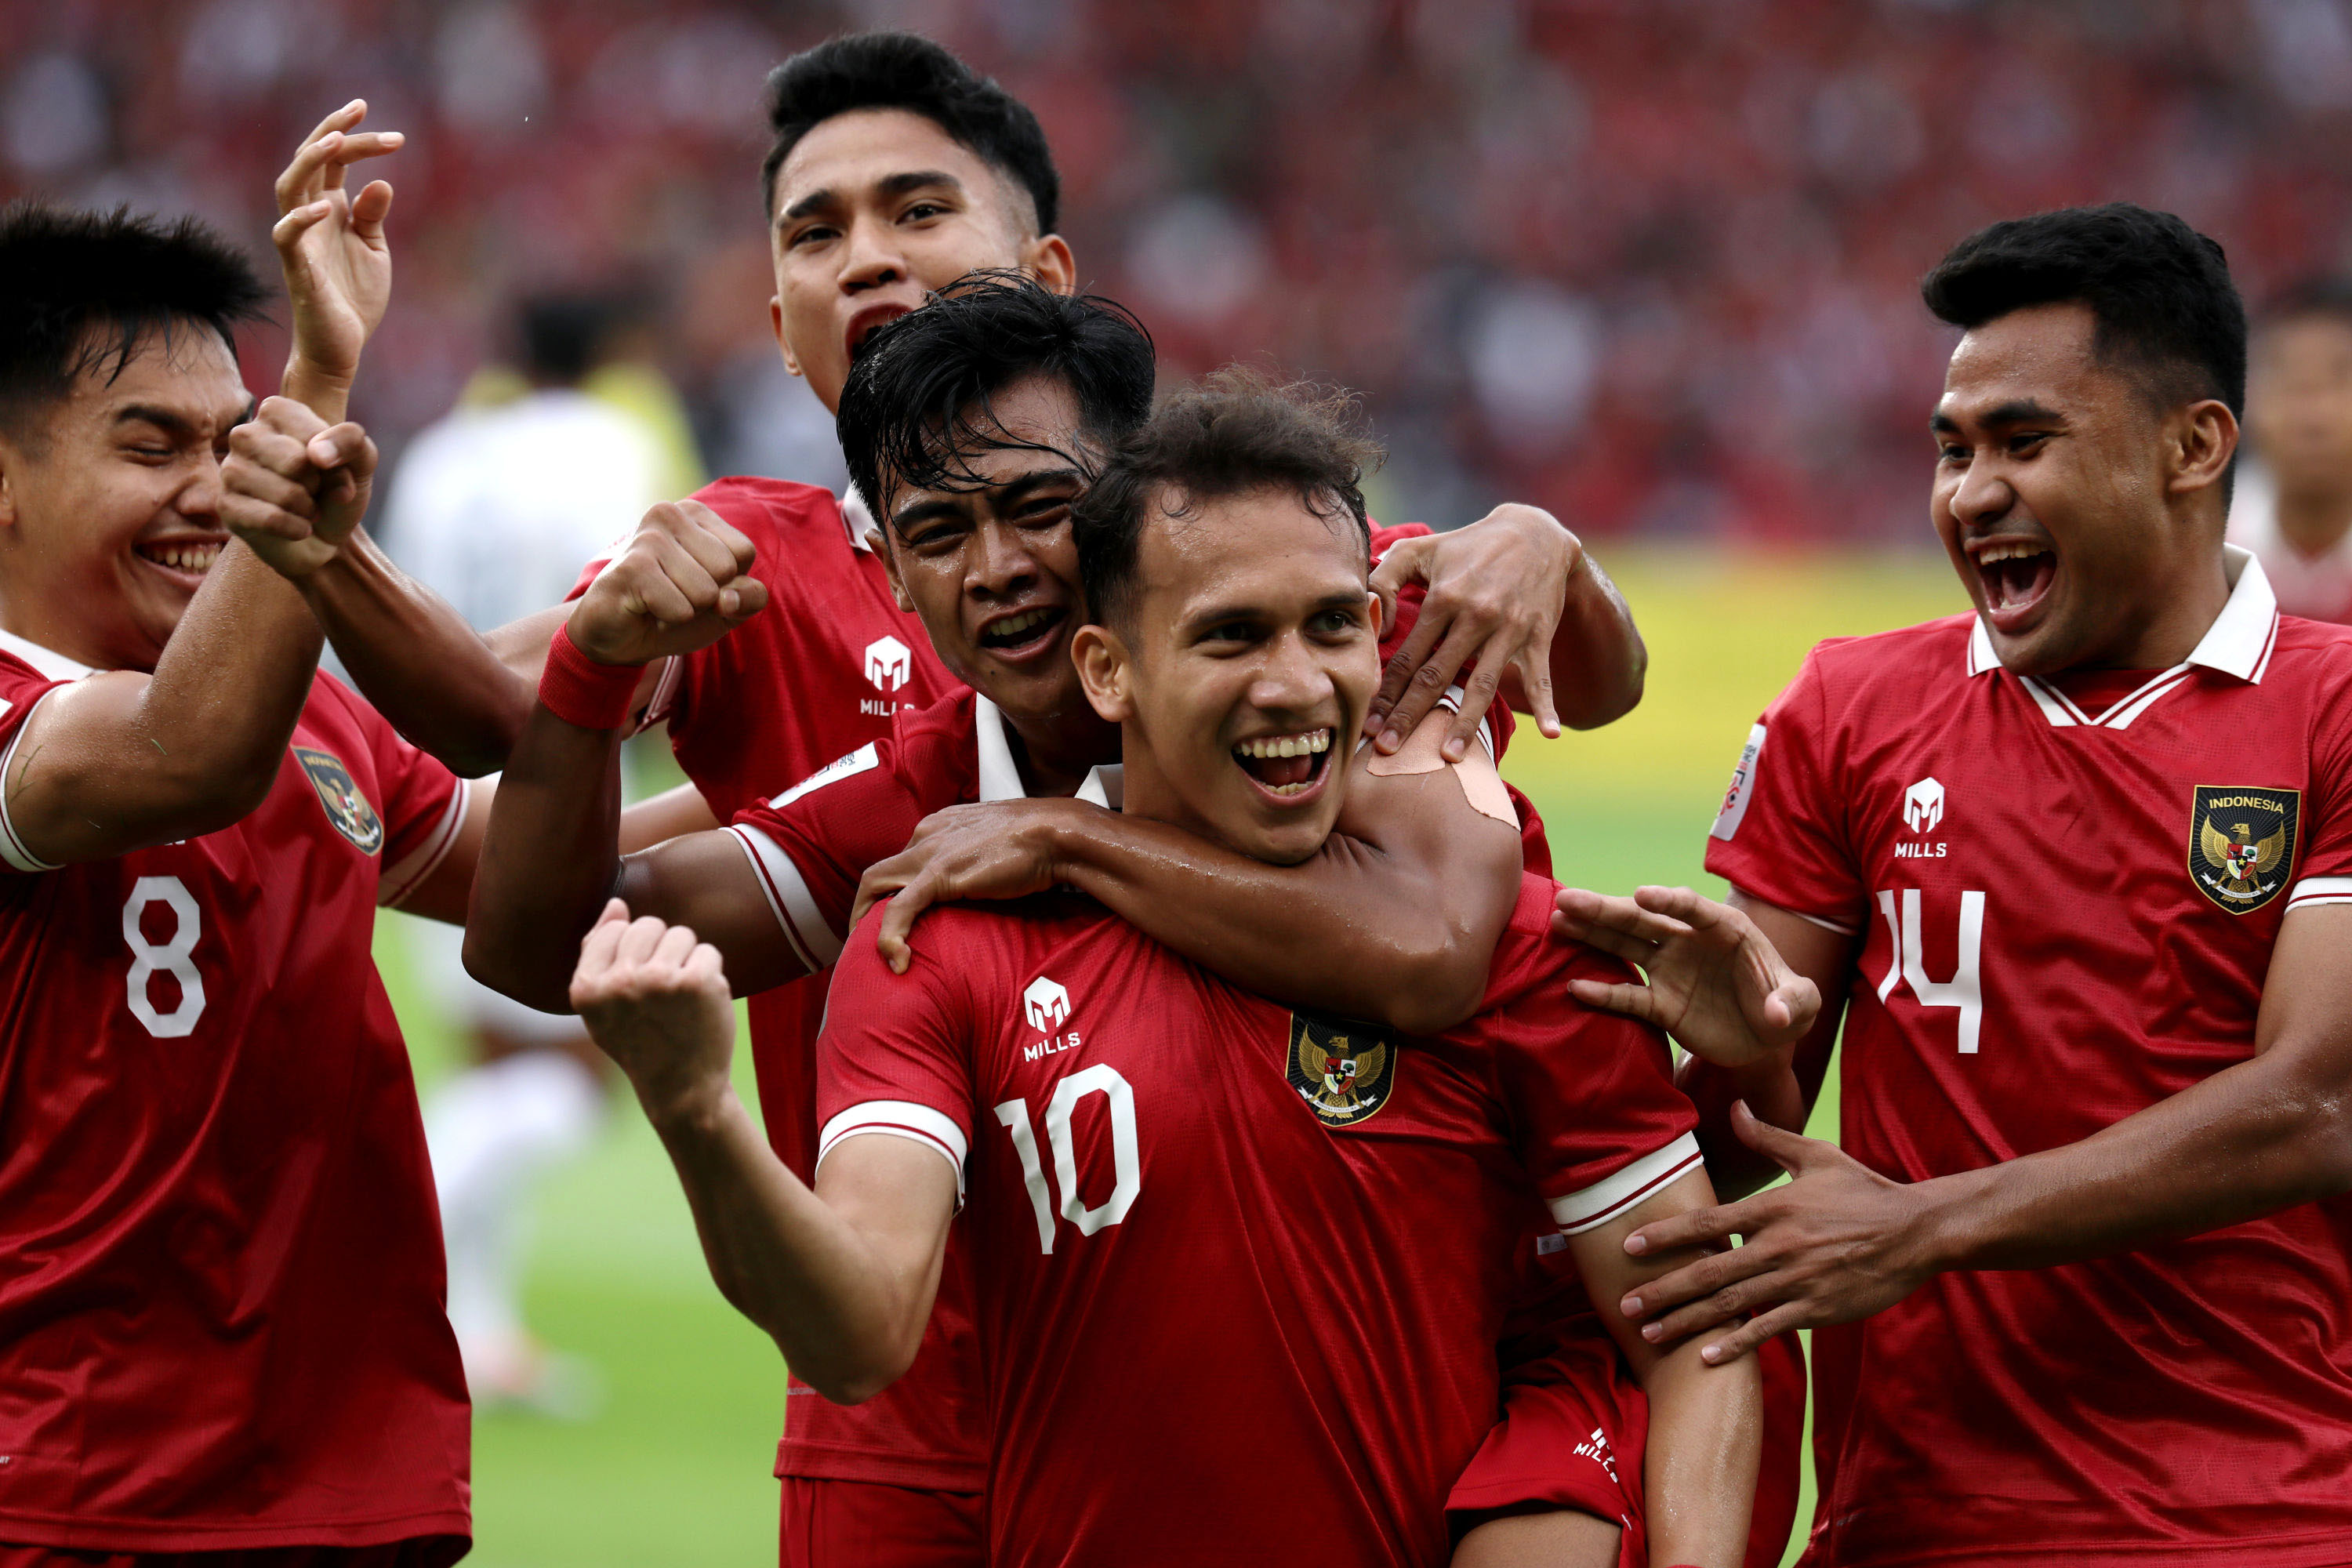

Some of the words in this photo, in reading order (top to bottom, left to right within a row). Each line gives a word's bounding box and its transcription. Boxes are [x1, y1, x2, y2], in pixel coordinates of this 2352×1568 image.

[1894, 842, 1947, 858] MILLS
[2209, 796, 2284, 815] INDONESIA
[122, 877, 206, 1038] 8
[1876, 888, 1986, 1054] 14
[1024, 1032, 1081, 1062] MILLS
[993, 1062, 1141, 1255] 10
